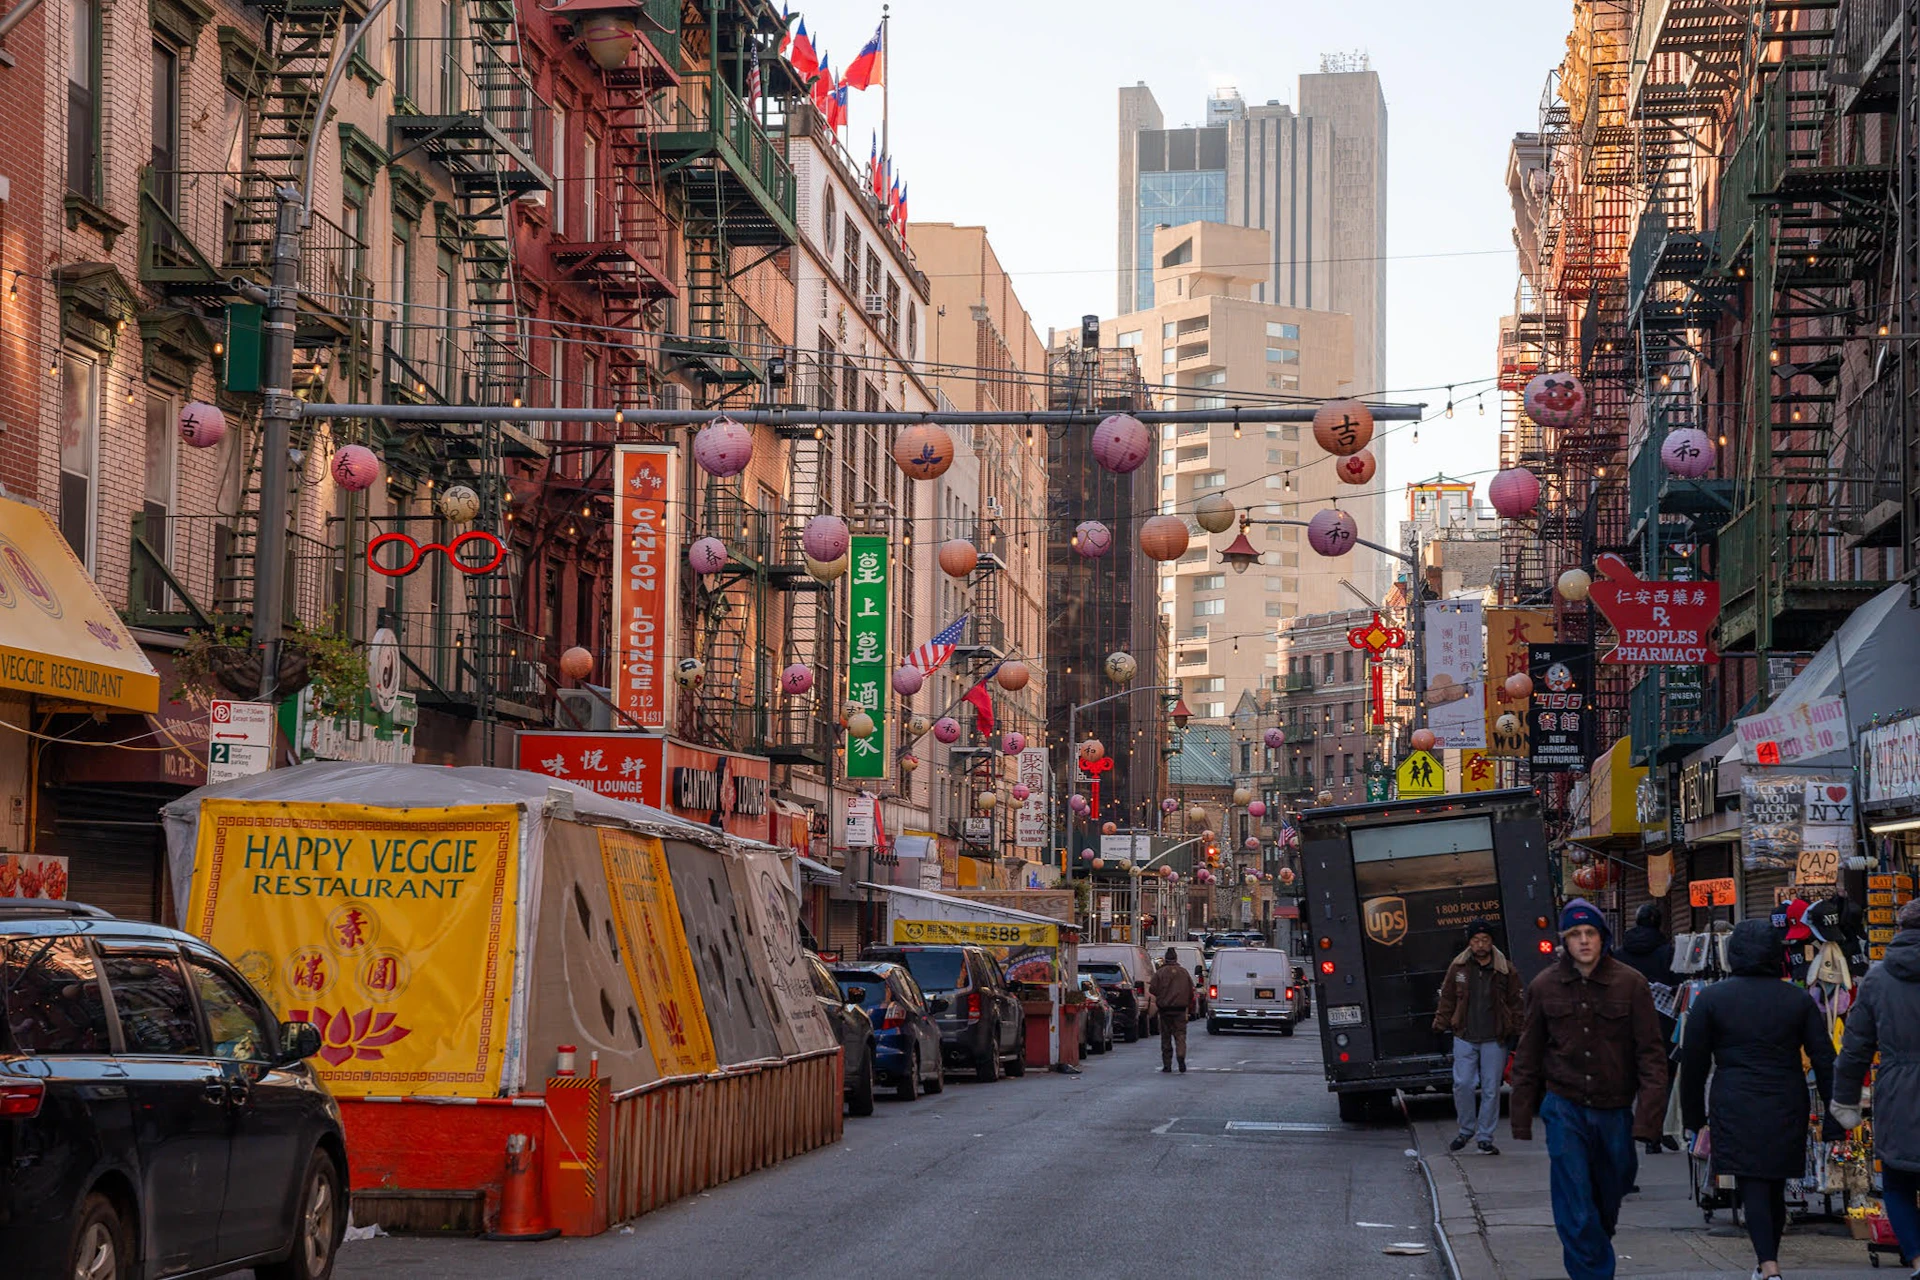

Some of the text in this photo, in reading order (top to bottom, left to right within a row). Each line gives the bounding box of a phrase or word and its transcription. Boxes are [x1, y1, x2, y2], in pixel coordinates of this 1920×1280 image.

[181, 412, 200, 438] 吉
[1331, 414, 1360, 447] 吉
[1673, 440, 1700, 462] 和
[336, 452, 355, 480] 春
[1325, 522, 1350, 544] 和
[631, 508, 657, 591] CANTON
[1616, 589, 1707, 606] 仁安西藥房
[1626, 630, 1698, 644] PEOPLES
[628, 606, 655, 689] LOUNGE
[1617, 647, 1707, 662] PHARMACY
[1, 653, 124, 698] VEGGIE RESTAURANT
[788, 673, 804, 687] 和
[630, 695, 654, 707] 212
[1535, 693, 1583, 709] 456
[943, 723, 956, 734] 和
[1502, 719, 1514, 733] 吉
[1740, 716, 1785, 742] WHITE
[1008, 737, 1018, 750] 吉
[1549, 735, 1567, 743] NEW
[1760, 742, 1773, 758] 4
[1817, 729, 1834, 748] 10
[214, 744, 226, 762] 2
[1084, 745, 1097, 754] 和
[1537, 745, 1579, 753] SHANGHAI
[1532, 755, 1585, 764] RESTAURANT
[597, 780, 643, 794] LOUNGE
[681, 767, 767, 815] CANTON LOUNGE
[1762, 794, 1789, 804] YOU
[1758, 813, 1792, 823] FUCK
[1809, 804, 1851, 821] NY
[1752, 827, 1800, 844] NYPD
[244, 835, 477, 874] HAPPY VEGGIE
[1800, 852, 1836, 872] CAP
[253, 875, 464, 899] RESTAURANT
[1718, 892, 1726, 903] 5
[1441, 903, 1458, 914] 800
[1461, 902, 1481, 912] PICK
[1482, 900, 1500, 910] UPS
[336, 909, 368, 949] 素
[989, 926, 1020, 941] $88
[1368, 911, 1405, 939] ups
